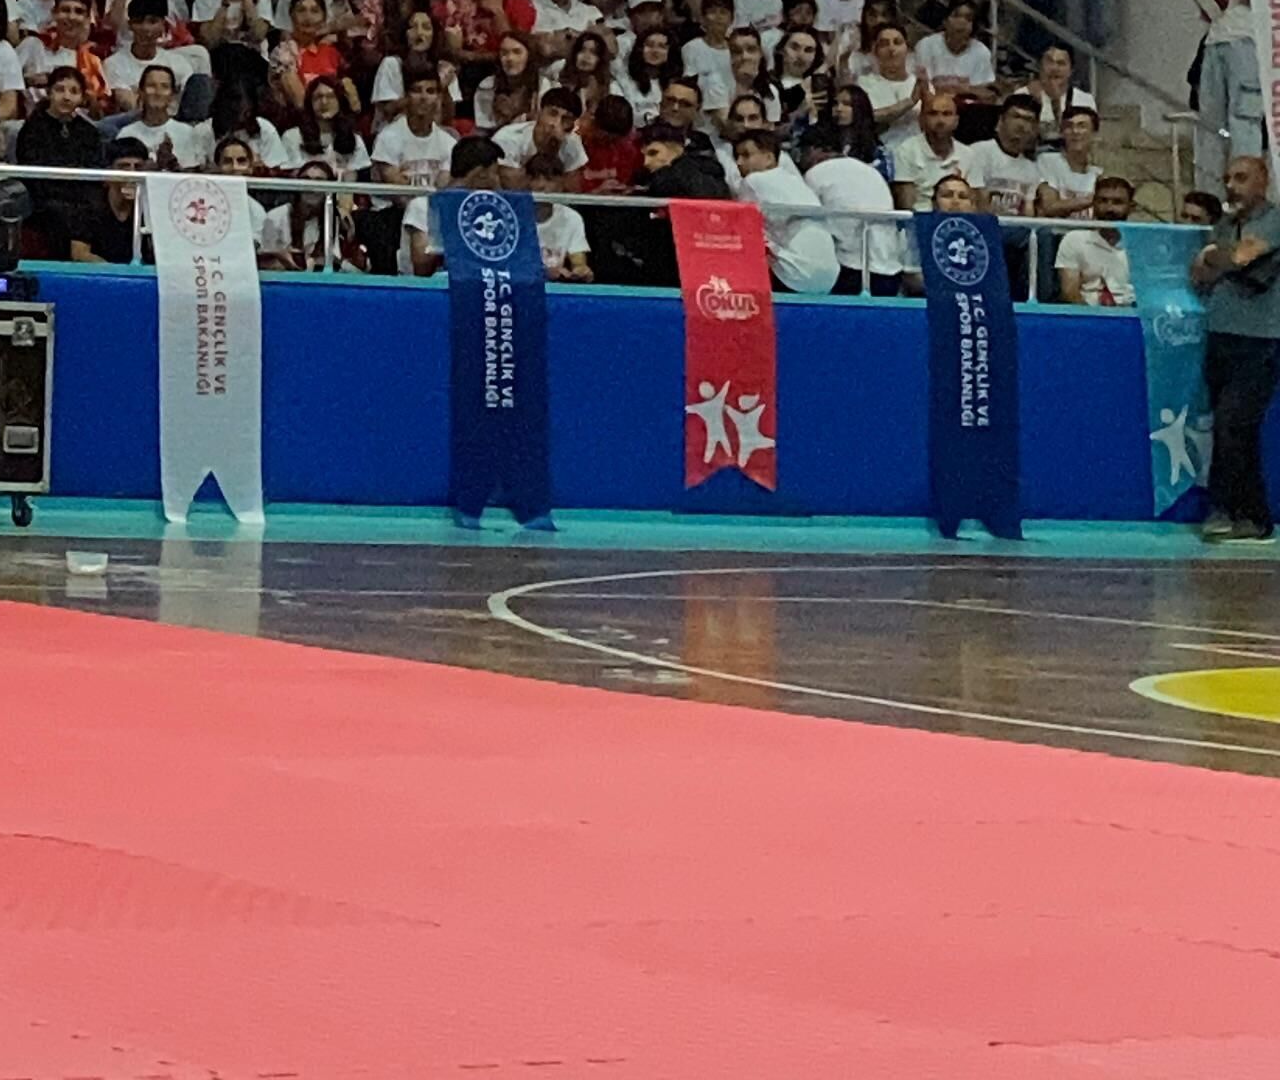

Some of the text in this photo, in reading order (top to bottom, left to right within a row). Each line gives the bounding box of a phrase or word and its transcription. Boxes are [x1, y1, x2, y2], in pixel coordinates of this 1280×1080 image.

[192, 255, 212, 396] SPOR BAKANLIĞI
[211, 290, 229, 367] GENÇLİK
[480, 267, 500, 408] SPOR BAKANLIĞI
[498, 303, 515, 380] GENÇLİK
[955, 292, 975, 427] SPOR BAKANLIĞI
[975, 326, 990, 399] GENÇLİK
[214, 374, 227, 395] VE
[500, 385, 514, 408] VE
[976, 405, 989, 426] VE
